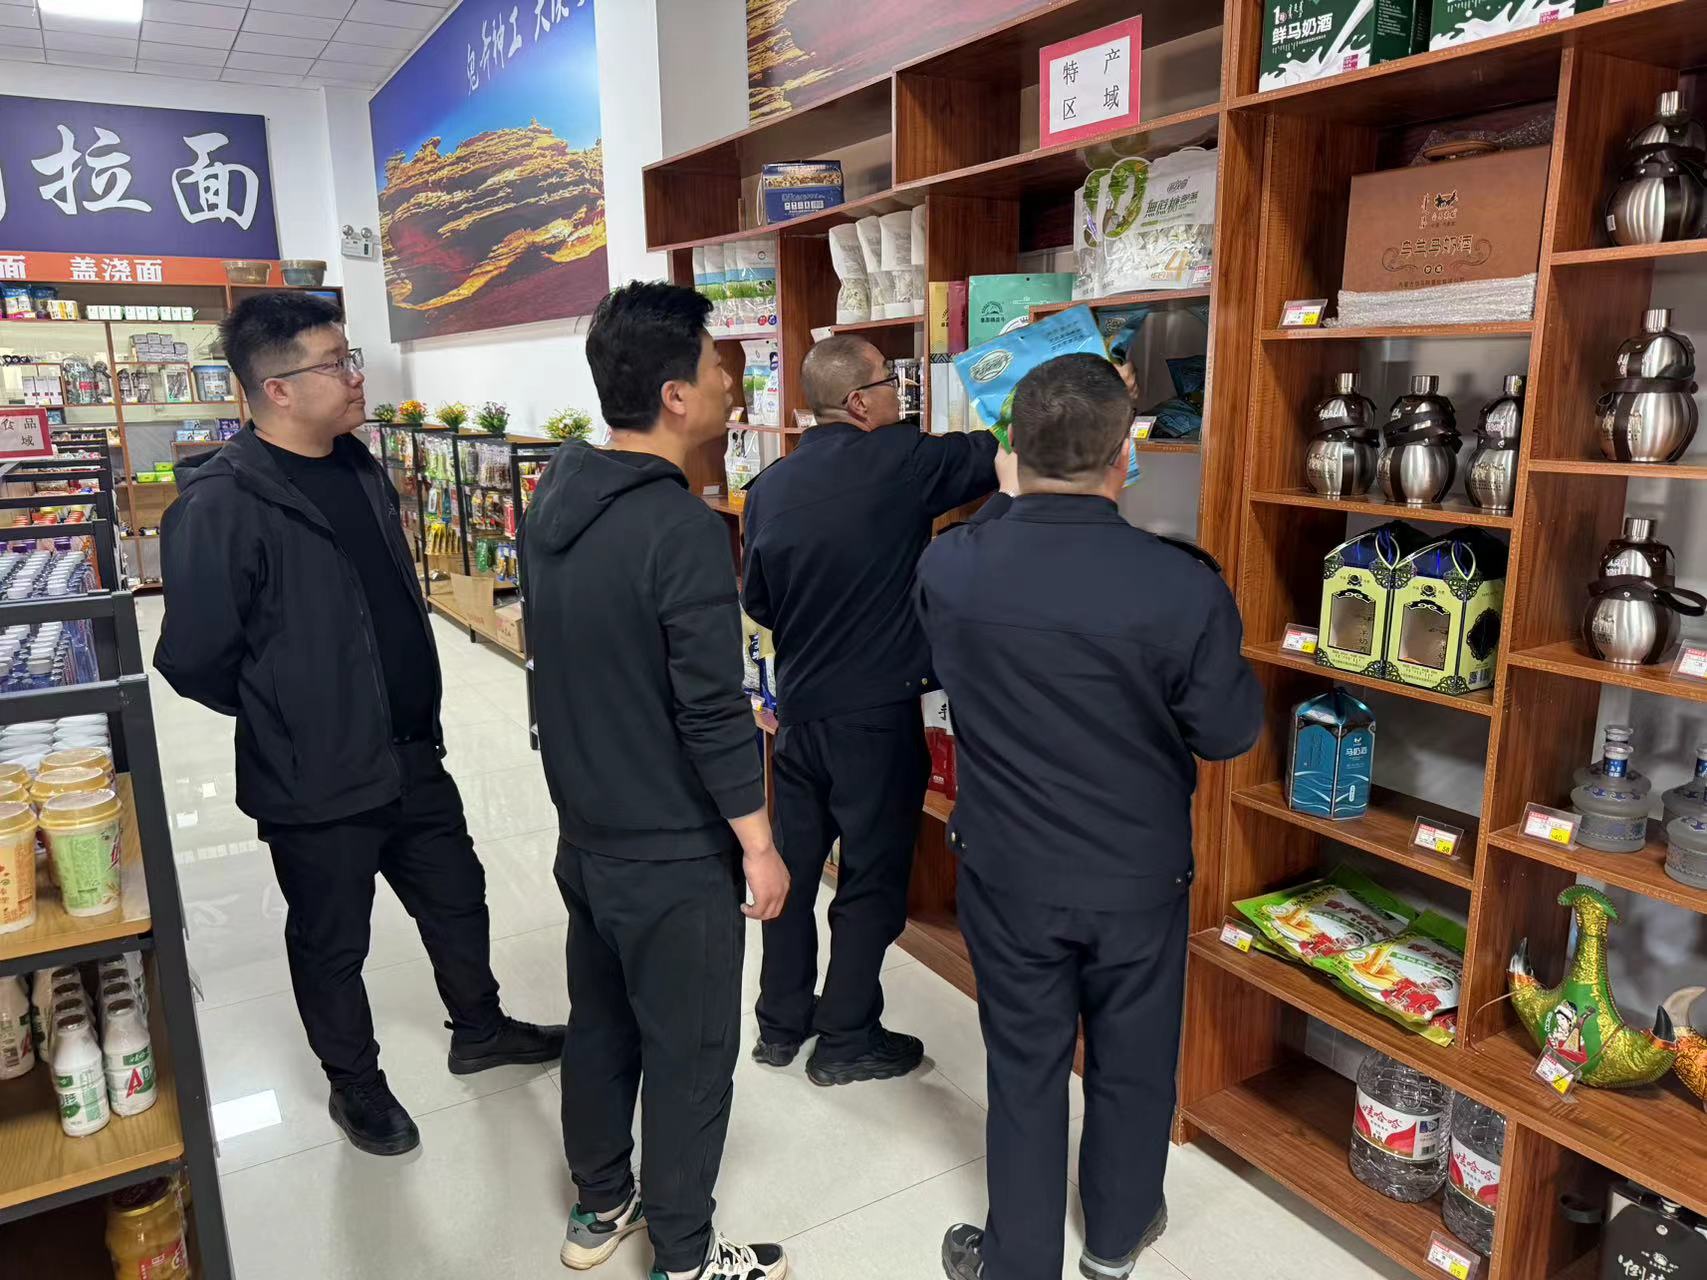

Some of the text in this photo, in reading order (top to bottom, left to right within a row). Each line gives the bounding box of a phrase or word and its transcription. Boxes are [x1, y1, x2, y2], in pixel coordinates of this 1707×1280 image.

[1272, 12, 1334, 46] 鲜马奶酒
[1062, 48, 1121, 85] 特产
[1063, 84, 1120, 120] 区域
[0, 124, 260, 231] 拉面
[69, 256, 164, 283] 盖浇面
[1361, 1104, 1402, 1130] 娃哈哈
[1455, 1152, 1496, 1181] 娃哈哈
